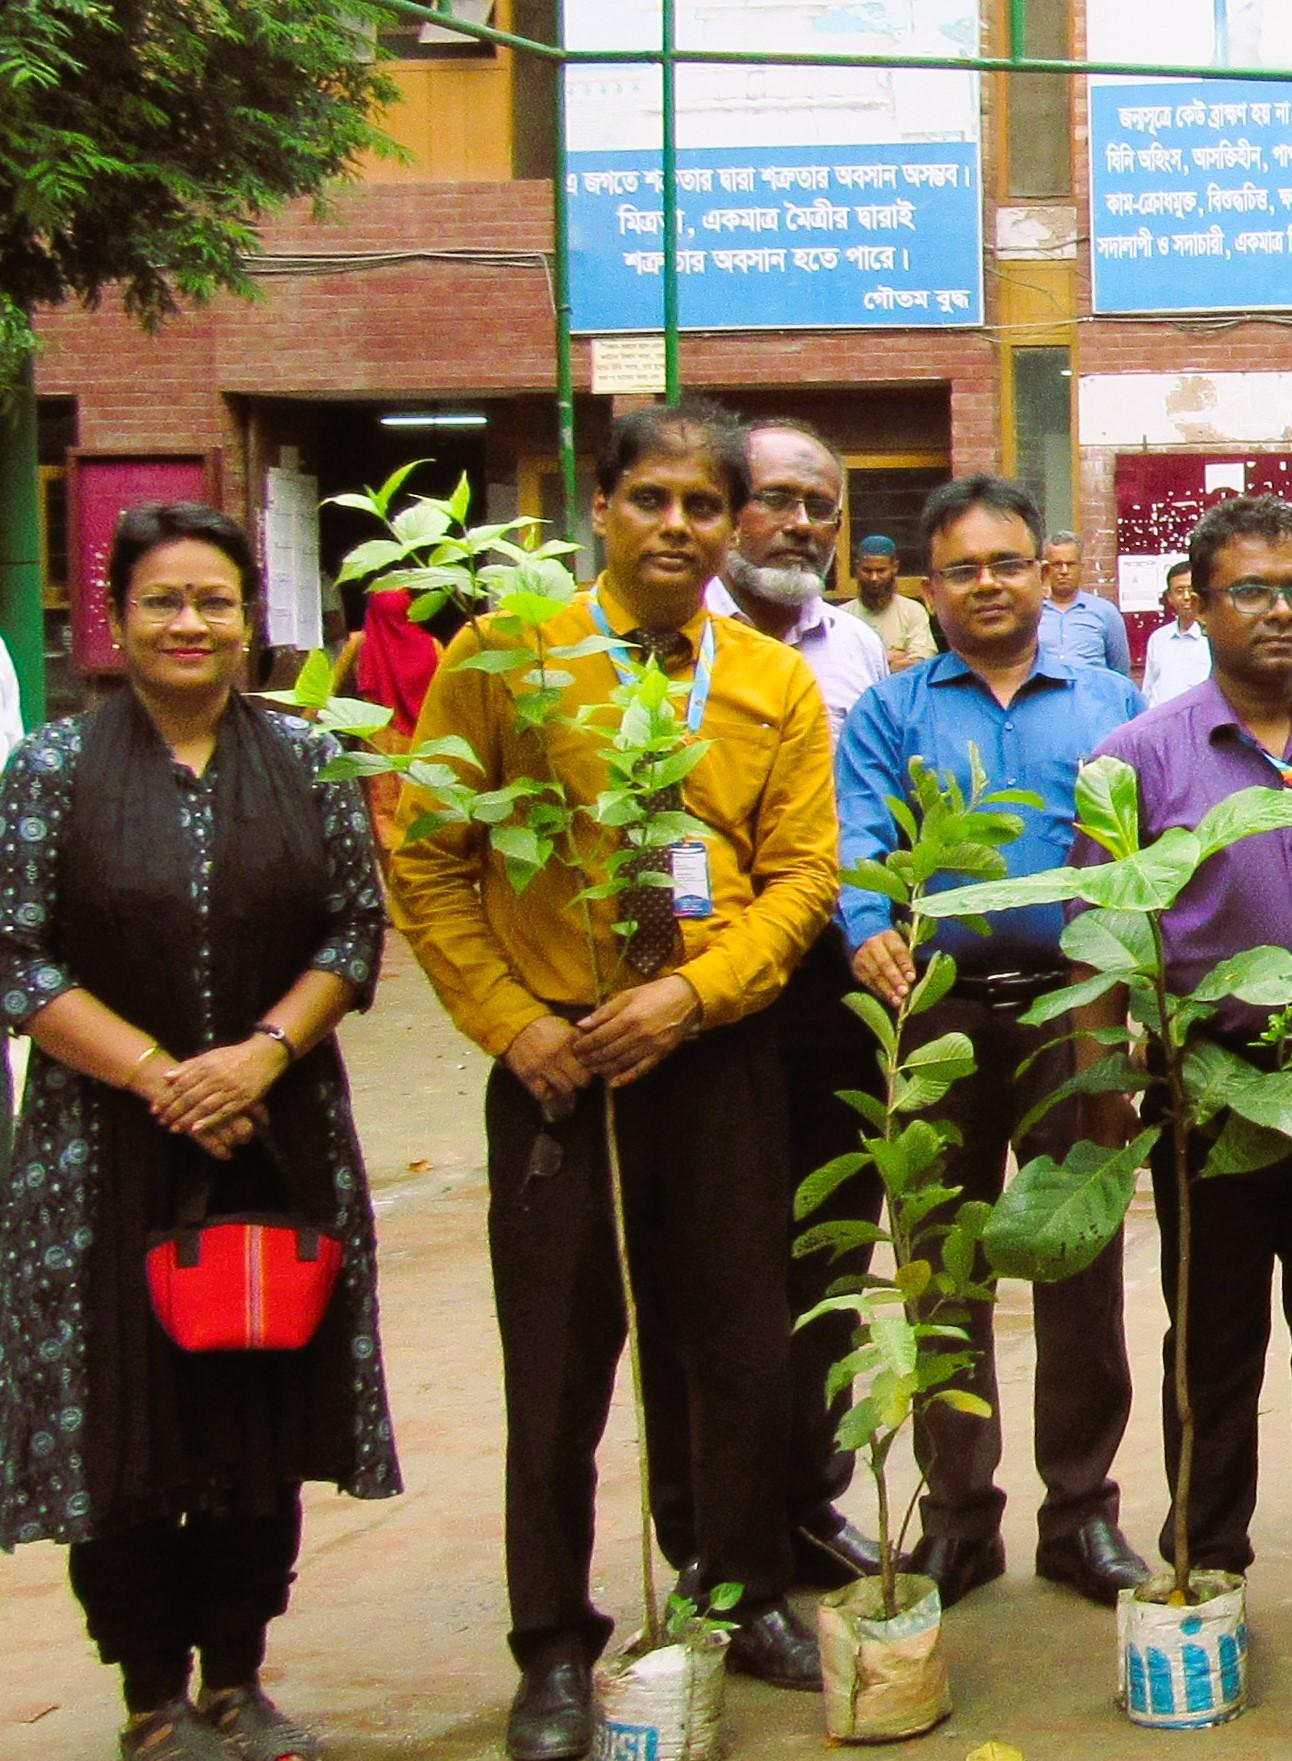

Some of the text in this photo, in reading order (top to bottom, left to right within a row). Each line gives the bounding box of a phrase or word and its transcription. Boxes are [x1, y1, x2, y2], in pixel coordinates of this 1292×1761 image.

[1175, 97, 1207, 128] কেউ
[1249, 102, 1272, 127] হয়
[1105, 143, 1136, 173] যিনি
[583, 170, 640, 196] জগতে
[717, 166, 756, 193] দ্বারা
[761, 164, 830, 191] শত্রুতার
[834, 163, 899, 190] অবসান
[703, 207, 781, 233] একমাত্র
[783, 198, 851, 232] মৈত্রীর
[854, 198, 917, 232] দ্বারাই
[1097, 227, 1154, 259] সদালাপী
[1156, 236, 1169, 256] ও
[1235, 229, 1285, 254] একমাত্র
[711, 246, 788, 275] অবসান
[790, 247, 841, 273] হতে
[863, 284, 971, 313] গৌতম বুদ্ধ
